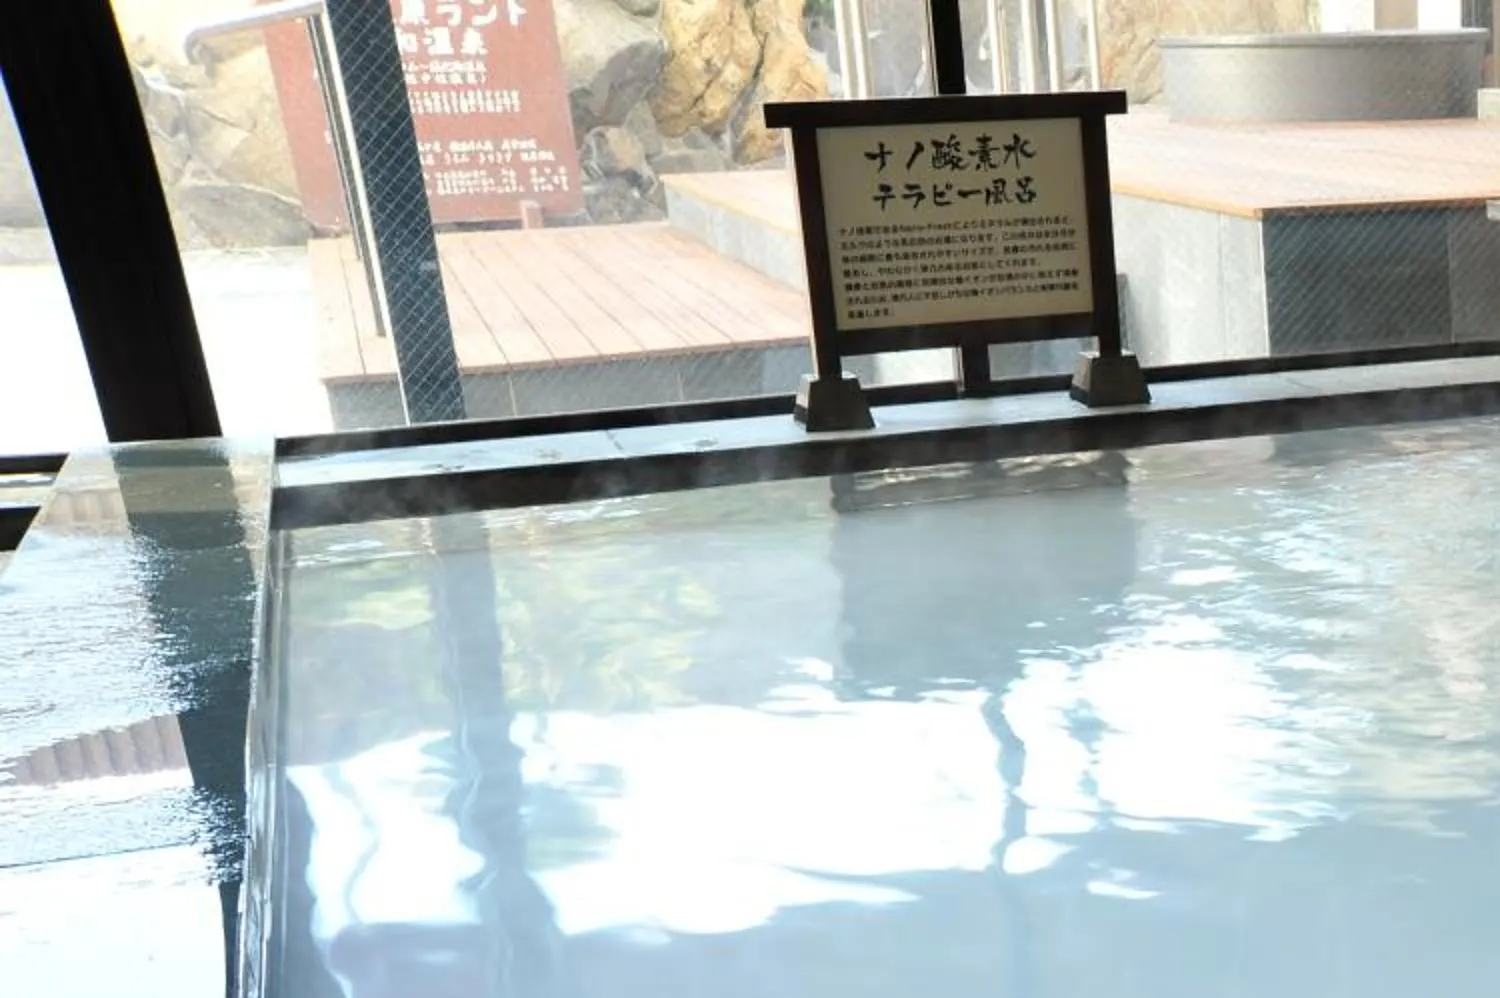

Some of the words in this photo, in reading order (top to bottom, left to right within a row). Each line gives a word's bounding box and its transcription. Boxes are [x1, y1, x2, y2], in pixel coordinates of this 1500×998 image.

[864, 134, 1038, 172] ナノ酸素水
